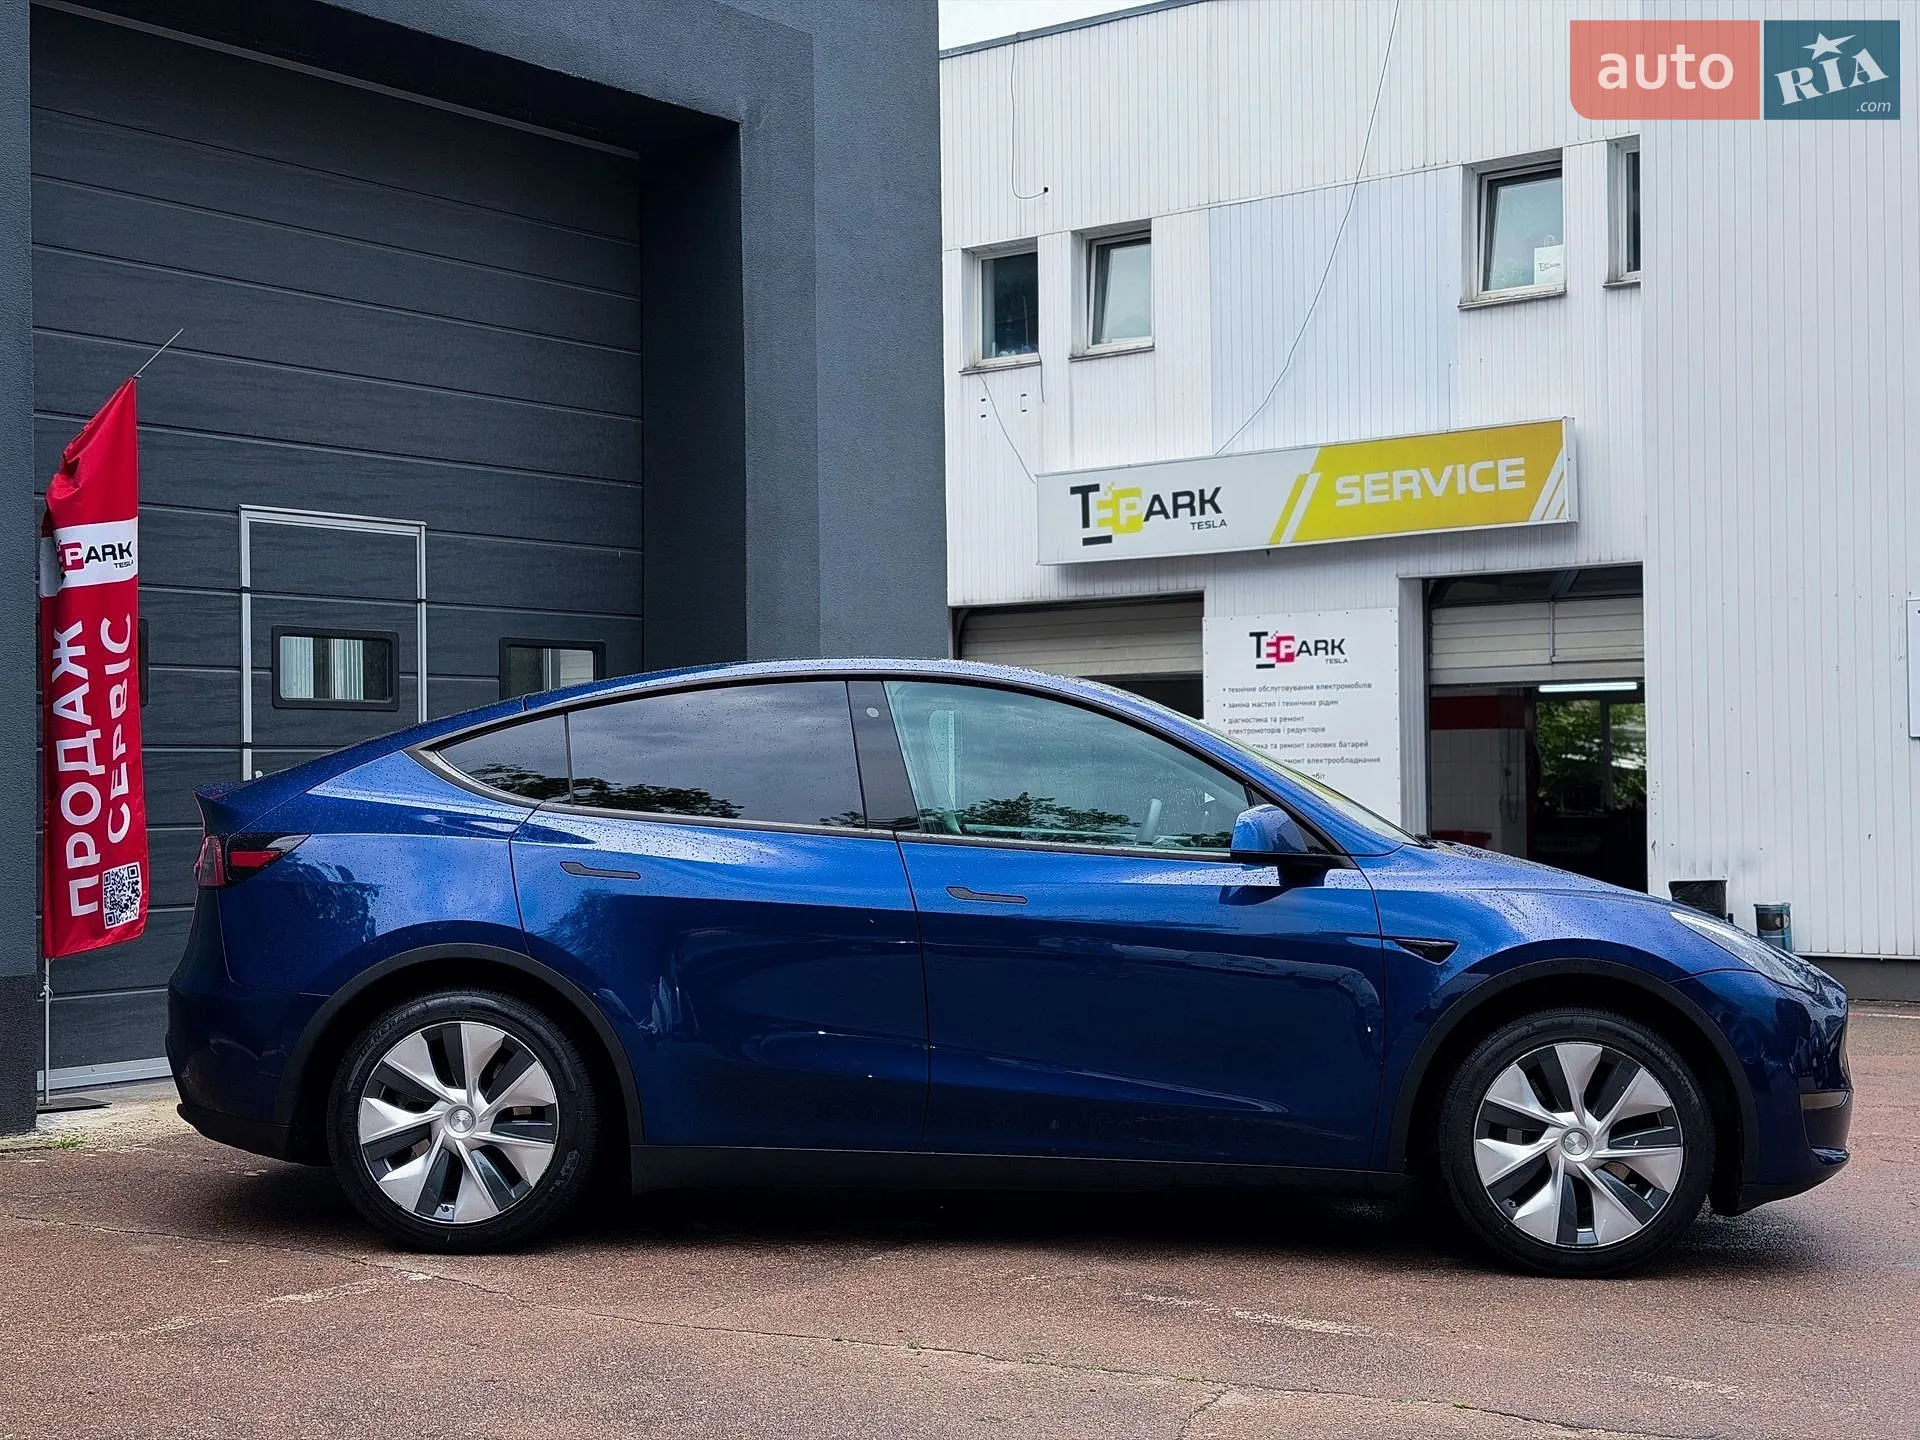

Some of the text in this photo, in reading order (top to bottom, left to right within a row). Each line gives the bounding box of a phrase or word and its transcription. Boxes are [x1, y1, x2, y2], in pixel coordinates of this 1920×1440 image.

[1335, 457, 1525, 508] SERVICE
[1190, 518, 1227, 531] TESLA
[100, 613, 131, 845] СЕРВІС
[1228, 716, 1268, 724] діагностика
[1279, 715, 1304, 723] ремонт
[1280, 742, 1305, 751] ремонт
[1339, 740, 1369, 749] батарей
[52, 620, 104, 917] ПРОДАЖ
